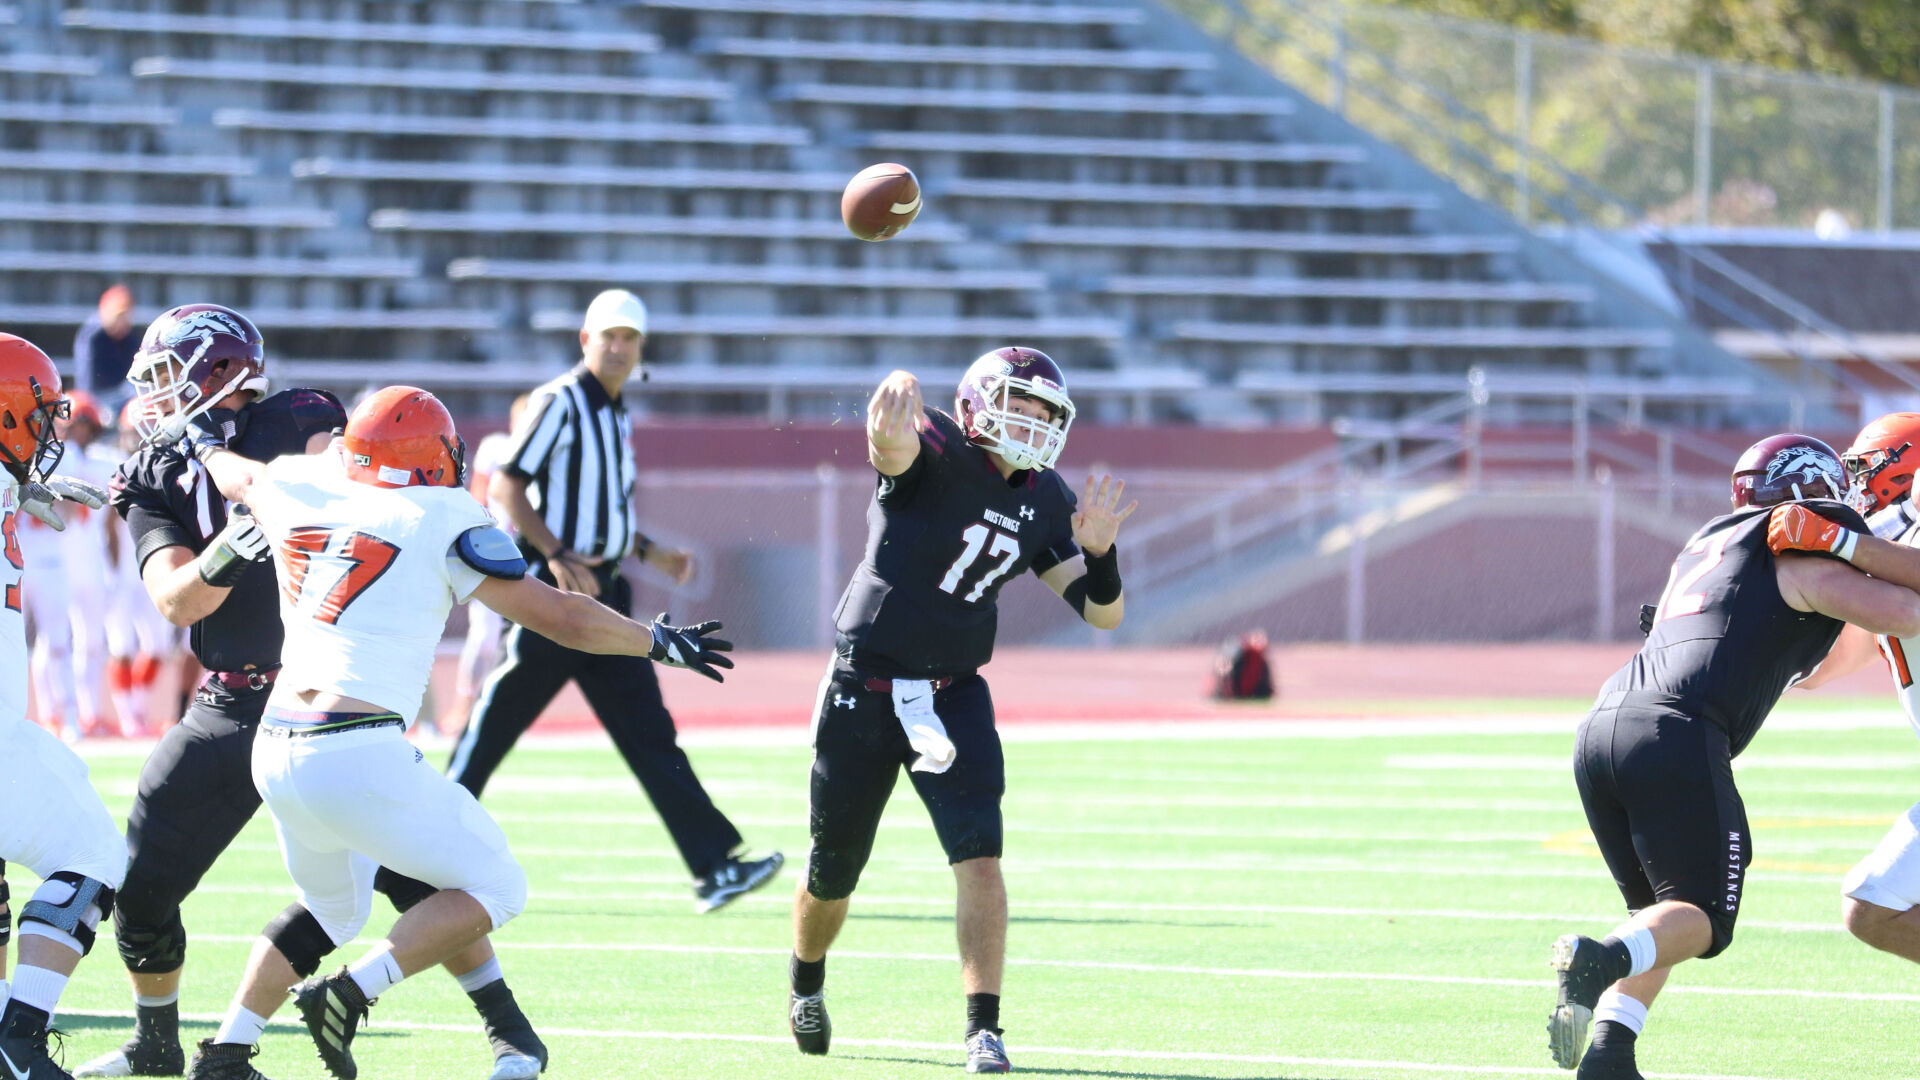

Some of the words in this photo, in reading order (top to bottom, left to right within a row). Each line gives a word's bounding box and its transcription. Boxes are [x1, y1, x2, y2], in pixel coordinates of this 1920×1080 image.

[983, 508, 1020, 533] MUSTANGS
[937, 522, 1021, 603] 17
[1726, 831, 1741, 912] MUSTANGS
